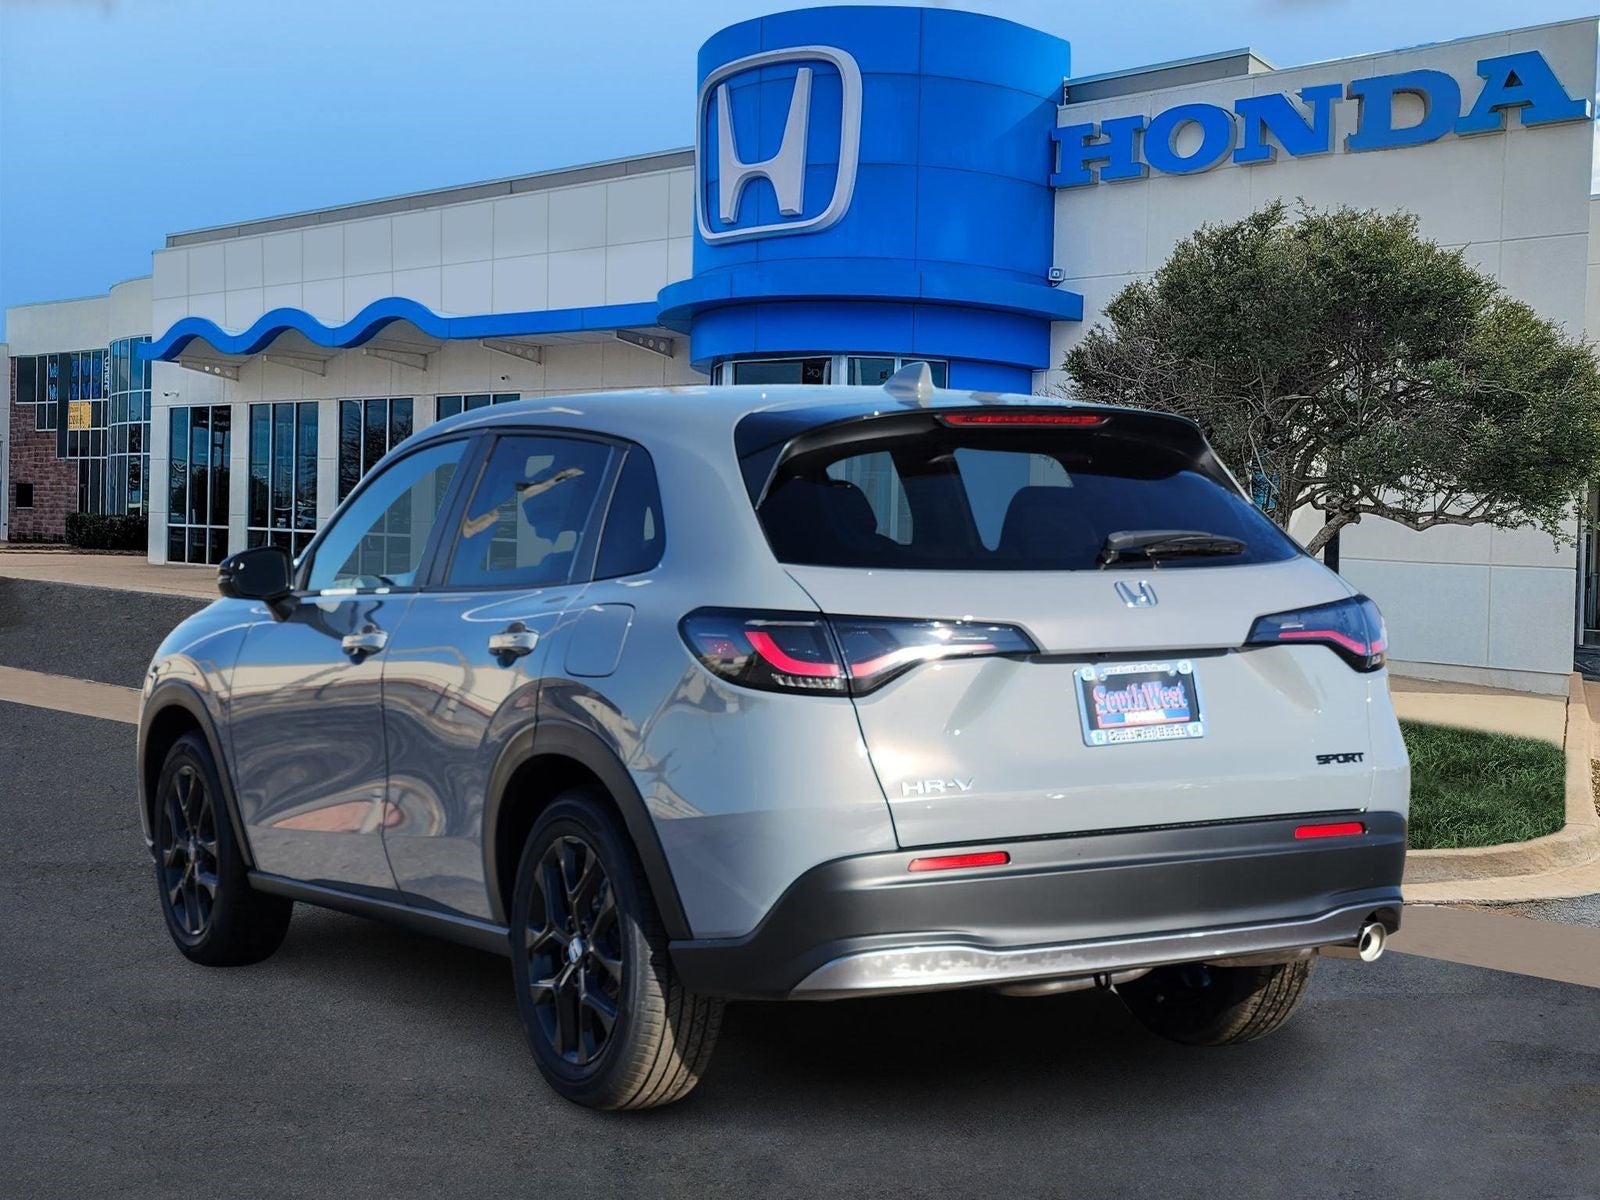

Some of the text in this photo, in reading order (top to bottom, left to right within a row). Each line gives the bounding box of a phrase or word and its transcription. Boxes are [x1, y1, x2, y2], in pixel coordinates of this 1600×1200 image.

[1051, 49, 1591, 188] HONDA
[1316, 752, 1364, 765] SPORT
[901, 777, 974, 796] HR-V
